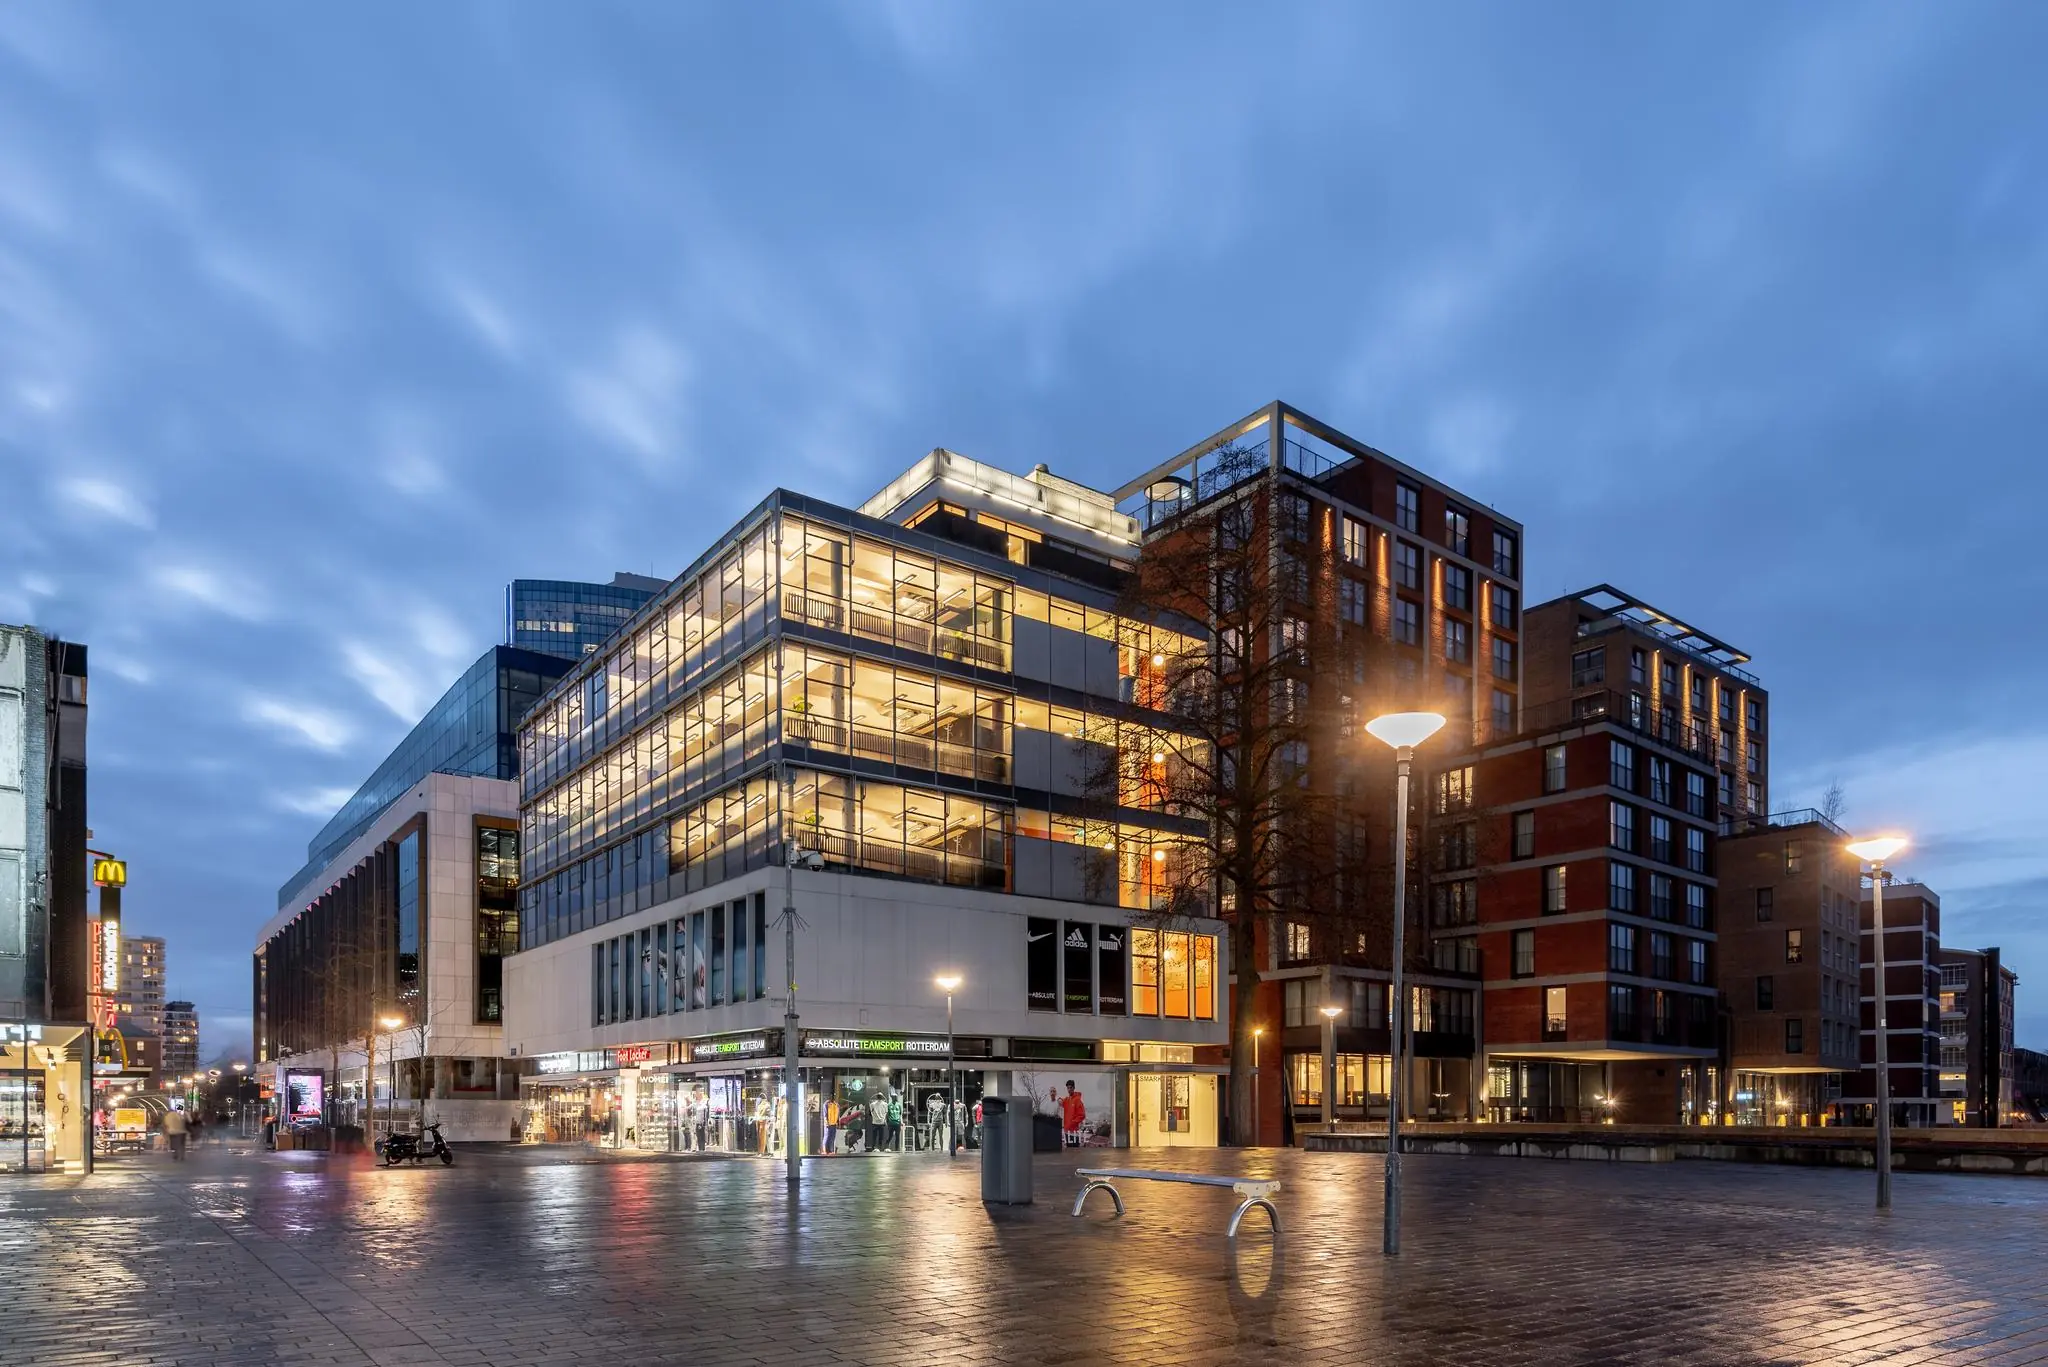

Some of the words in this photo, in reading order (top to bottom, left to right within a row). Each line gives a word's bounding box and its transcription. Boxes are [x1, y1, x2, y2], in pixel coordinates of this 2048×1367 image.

[1064, 940, 1088, 948] adidas
[906, 1041, 950, 1051] ROTTERDAM
[617, 1050, 629, 1062] Foot
[630, 1047, 648, 1061] Locker
